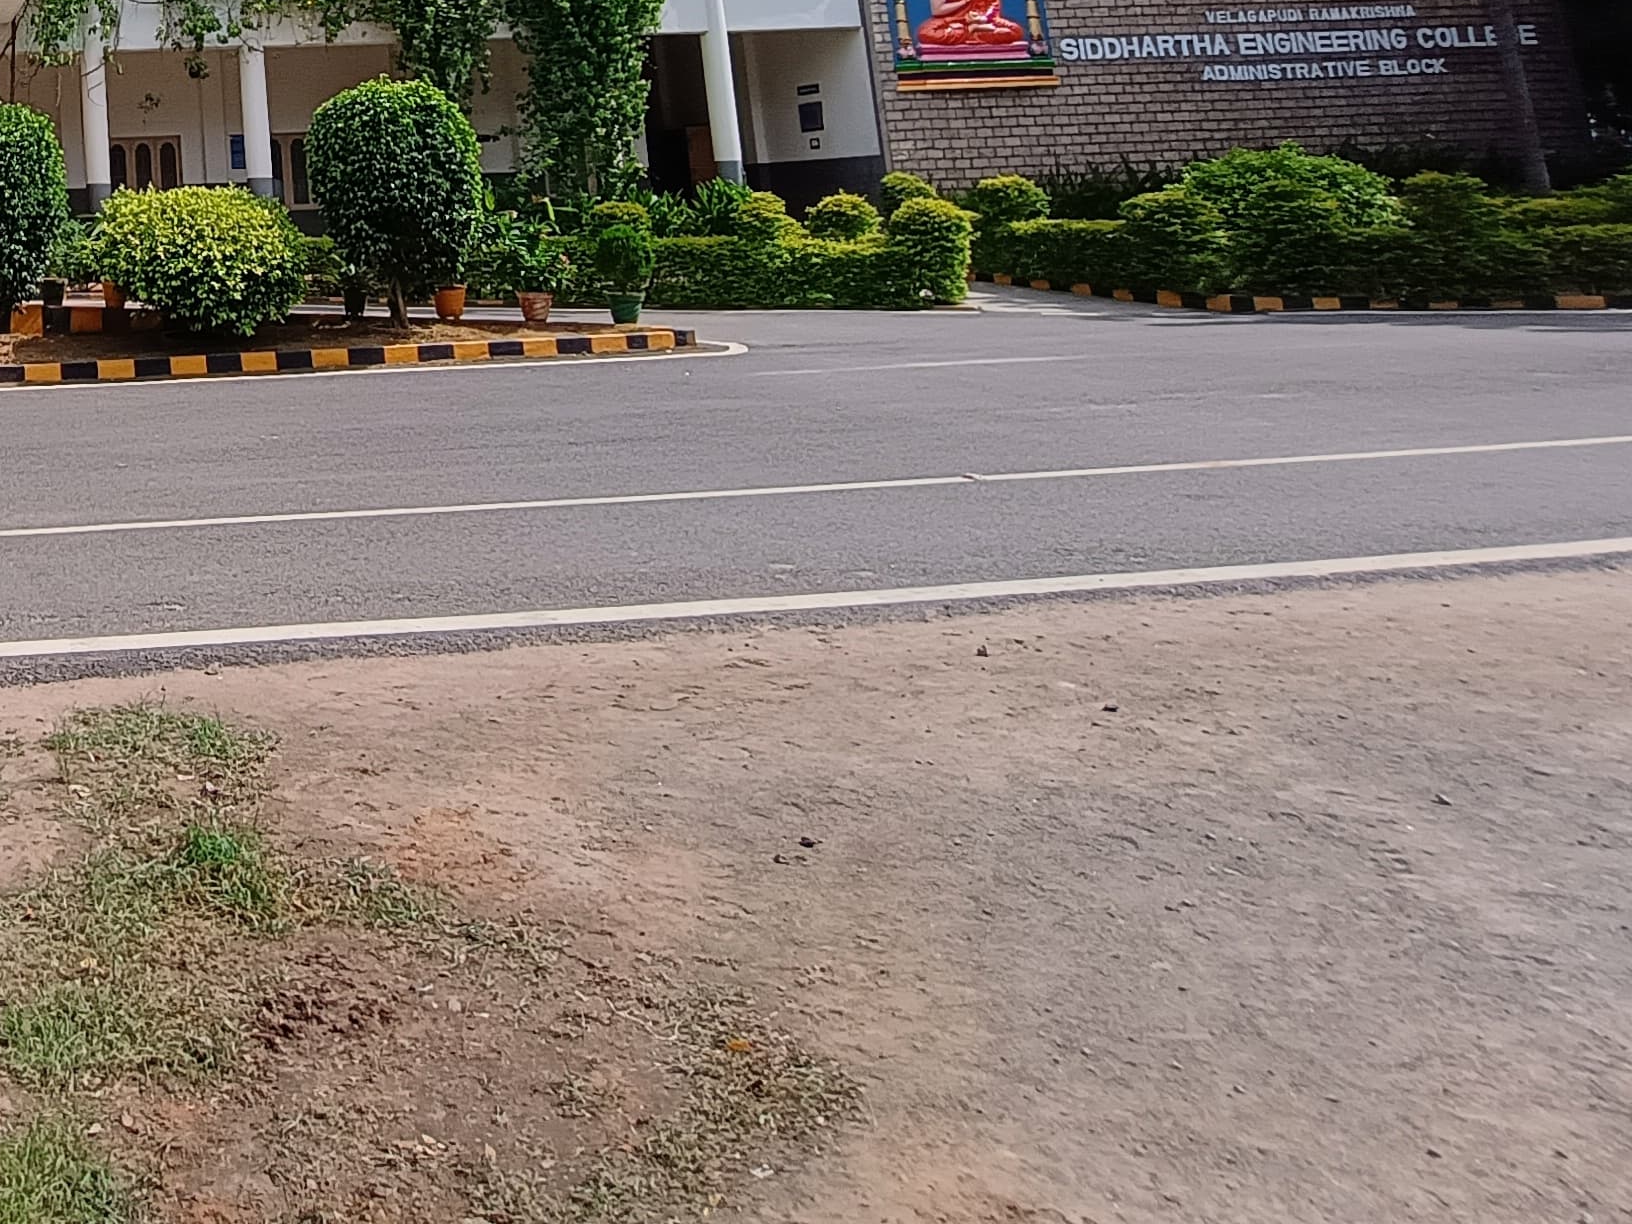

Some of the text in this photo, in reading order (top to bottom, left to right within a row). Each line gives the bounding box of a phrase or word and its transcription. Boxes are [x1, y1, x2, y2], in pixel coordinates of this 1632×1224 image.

[1204, 5, 1417, 24] VELAGAPUDI RAMAKRISHNA
[1059, 24, 1539, 61] SIDDHARTHA ENGINEERING COLLEE
[1201, 57, 1446, 81] ADMINISTRATIVE BLOCK
